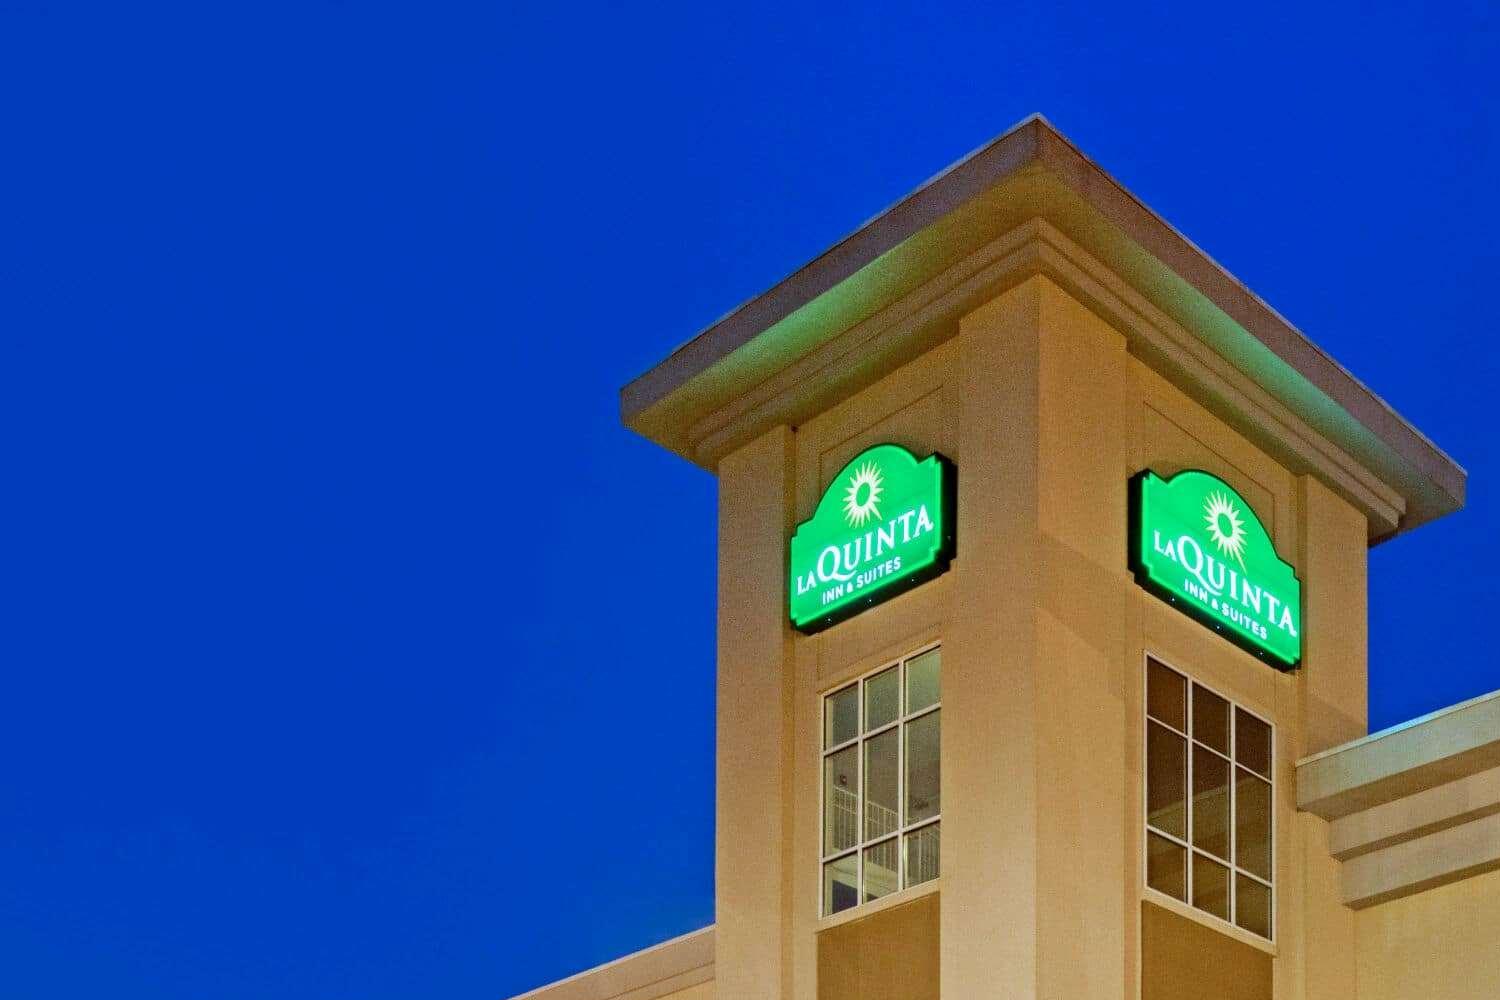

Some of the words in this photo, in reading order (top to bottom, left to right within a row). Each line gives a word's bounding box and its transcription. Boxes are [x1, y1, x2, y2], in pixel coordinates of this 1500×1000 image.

[797, 571, 816, 595] LA
[817, 504, 934, 582] QUINTA
[822, 582, 844, 604] INN
[847, 583, 854, 593] &
[857, 556, 901, 588] SUITES
[1153, 530, 1177, 561] LA
[1177, 535, 1297, 637] QUINTA
[1184, 579, 1208, 603] INN
[1211, 599, 1218, 610] &
[1222, 603, 1267, 640] SUITES
